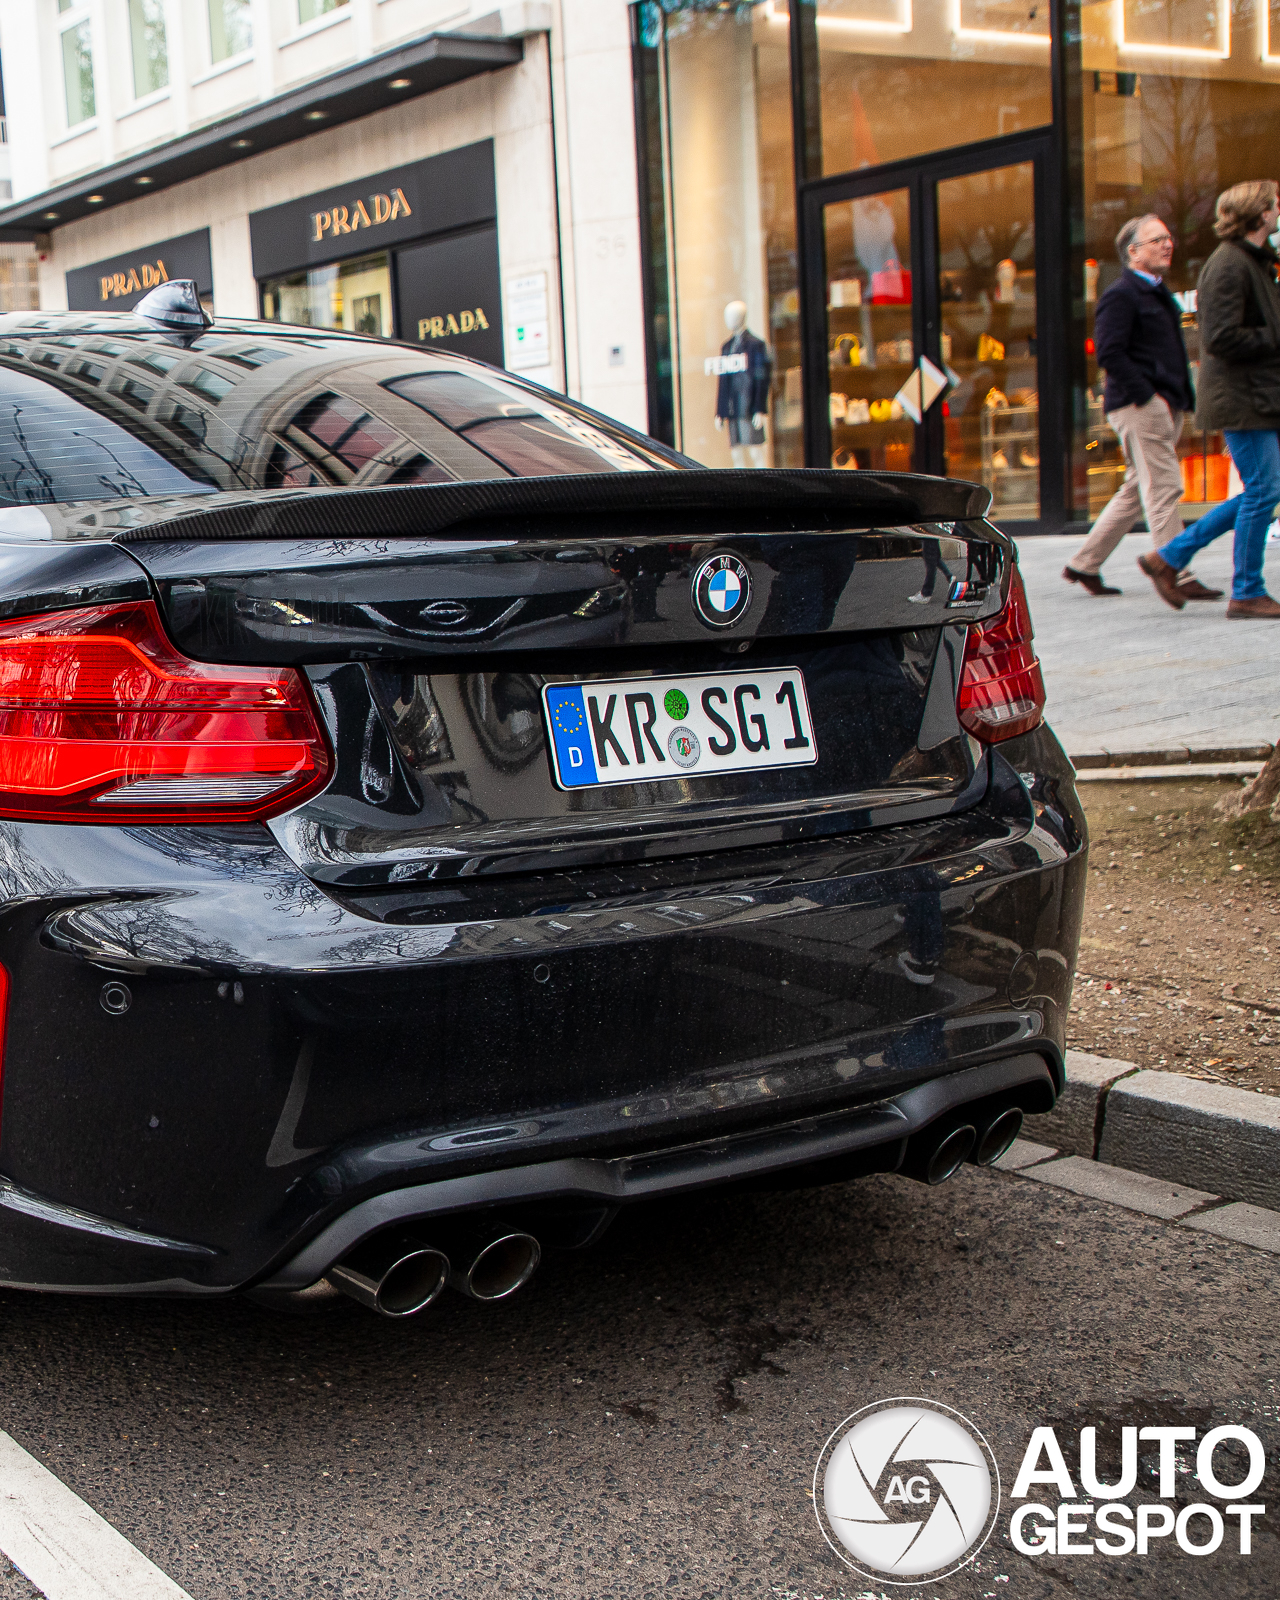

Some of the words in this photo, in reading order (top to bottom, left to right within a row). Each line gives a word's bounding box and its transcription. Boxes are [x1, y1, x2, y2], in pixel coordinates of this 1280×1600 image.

[311, 187, 412, 241] PRADA
[101, 259, 169, 300] PRADA
[418, 307, 489, 340] PRADA
[704, 353, 748, 376] FENDI
[703, 557, 747, 580] BMW
[587, 692, 666, 768] KR
[568, 746, 584, 768] D
